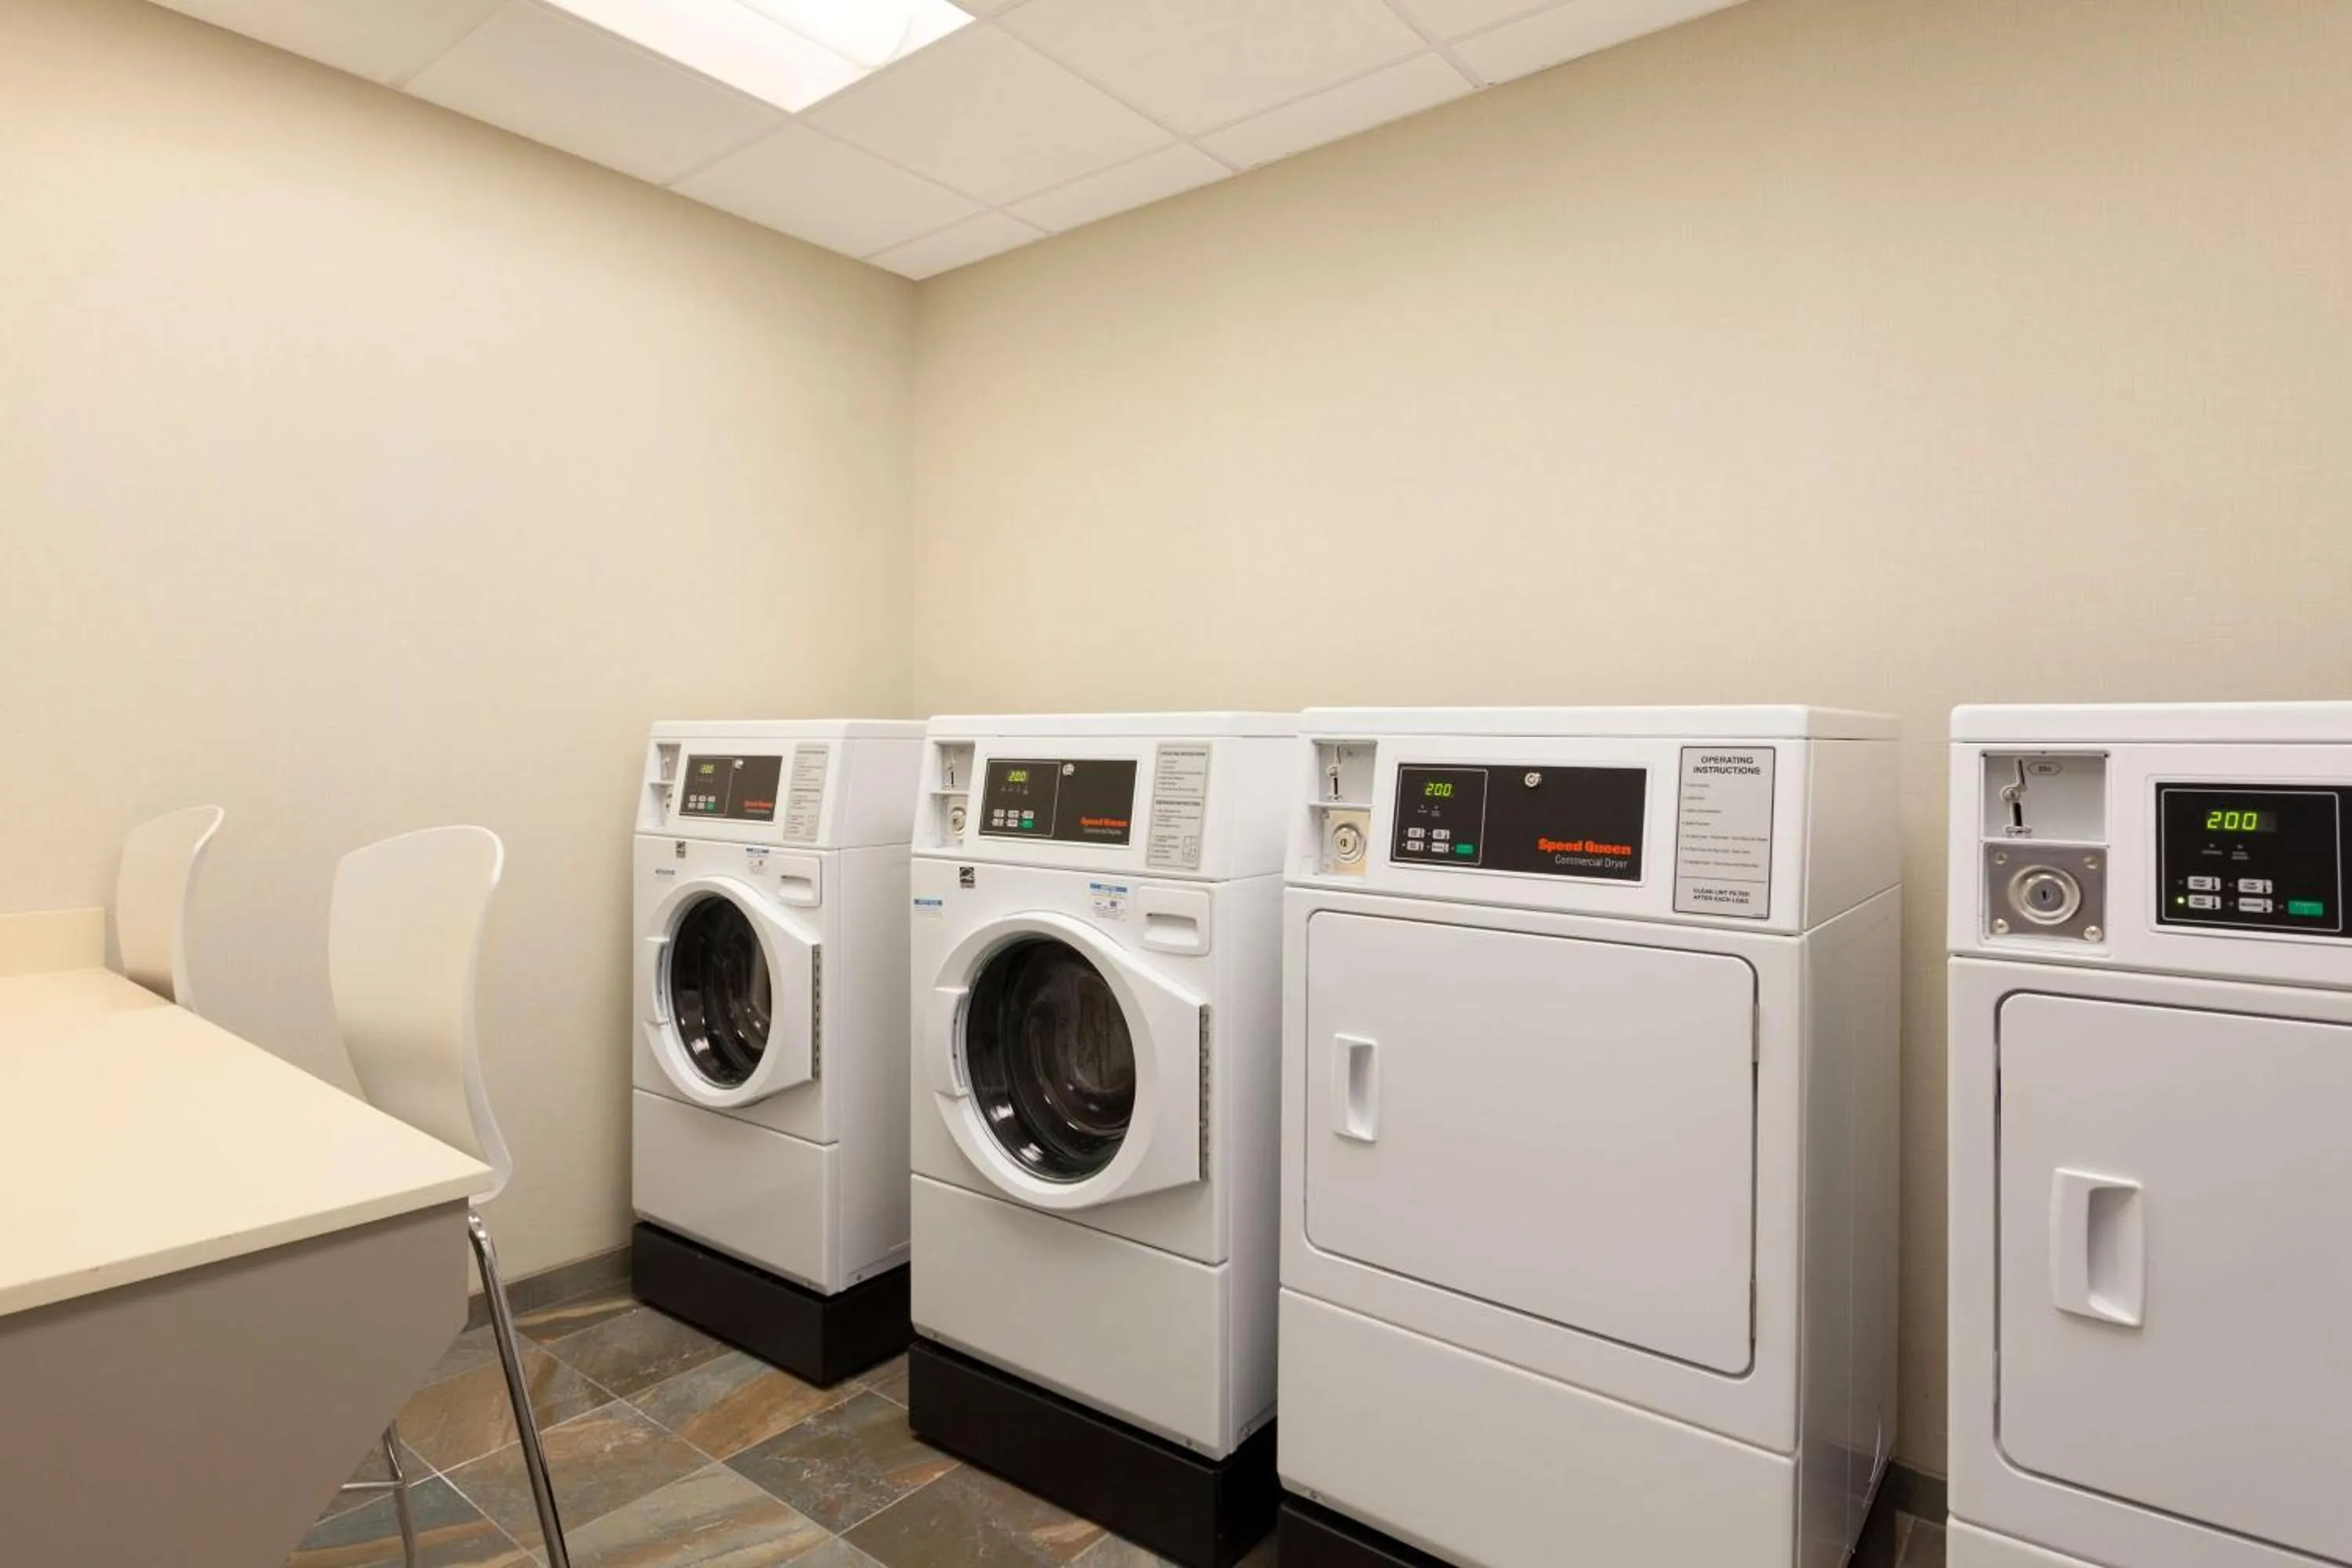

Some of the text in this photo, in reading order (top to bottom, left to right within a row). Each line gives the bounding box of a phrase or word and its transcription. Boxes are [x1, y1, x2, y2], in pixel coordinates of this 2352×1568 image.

[1701, 756, 1754, 764] OPERATING
[1693, 766, 1761, 775] INSTRUCTIONS
[1425, 782, 1452, 797] 200
[2207, 811, 2258, 830] 200
[1538, 838, 1632, 855] Speed Queen
[1555, 854, 1628, 869] Commercial Dryer
